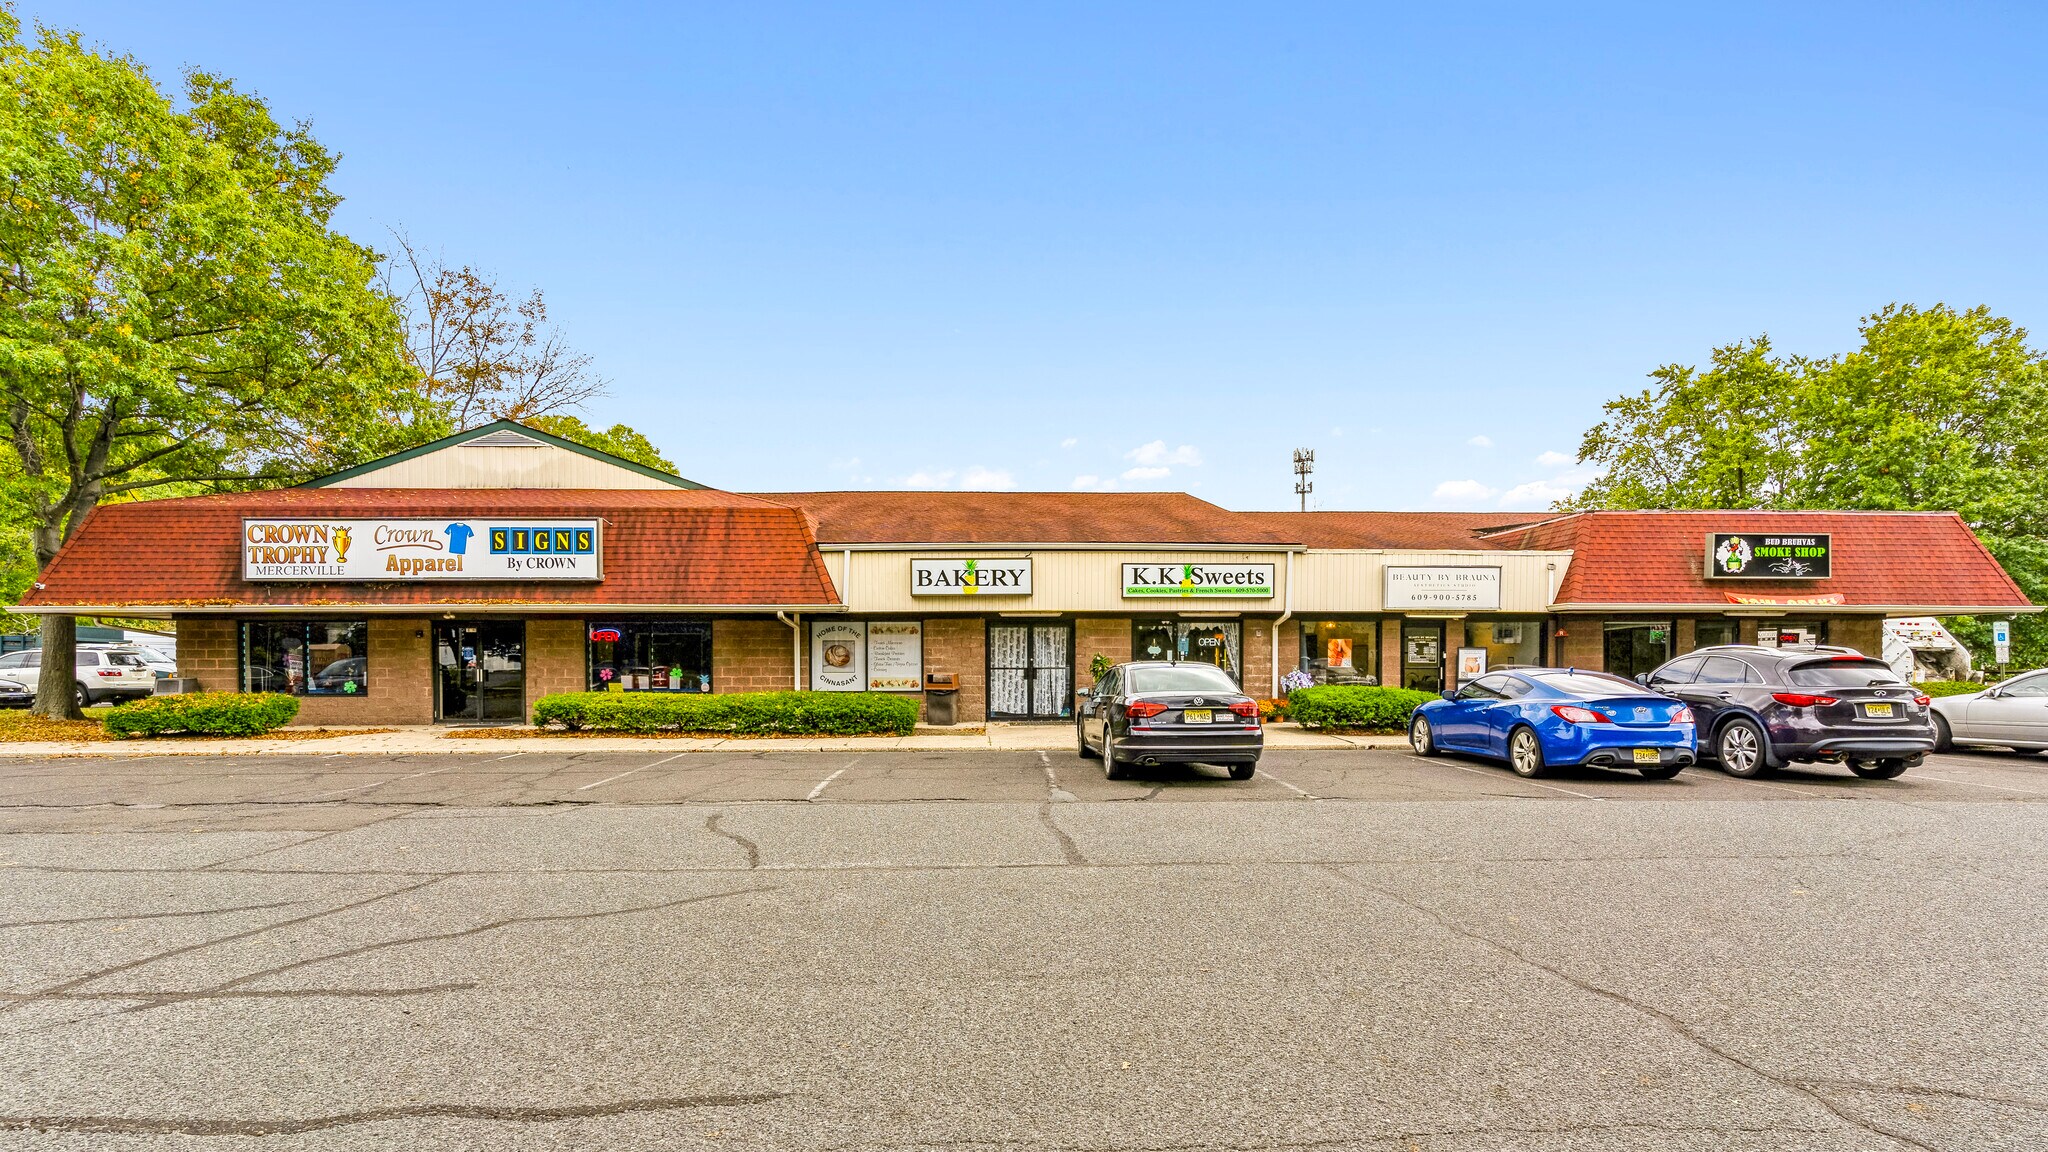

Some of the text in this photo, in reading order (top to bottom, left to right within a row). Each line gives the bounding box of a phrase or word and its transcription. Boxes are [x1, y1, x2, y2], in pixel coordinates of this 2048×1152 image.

[247, 524, 329, 543] CROWN
[374, 525, 438, 546] Crown
[494, 531, 590, 550] SIGNS
[1782, 538, 1815, 546] BRUHVAS
[248, 546, 329, 564] TROPHY
[1754, 547, 1826, 557] SMOKE SHOP
[256, 565, 345, 576] MERCERVILLE
[386, 554, 463, 575] Apparel
[507, 557, 576, 571] By CROWN
[916, 569, 1025, 587] BAKERY
[1131, 567, 1265, 585] K.K. Sweets
[591, 631, 619, 642] OPEN
[816, 625, 836, 639] HOME
[848, 627, 861, 639] THE
[1198, 637, 1221, 646] OPEN
[819, 674, 858, 687] CINNASANT
